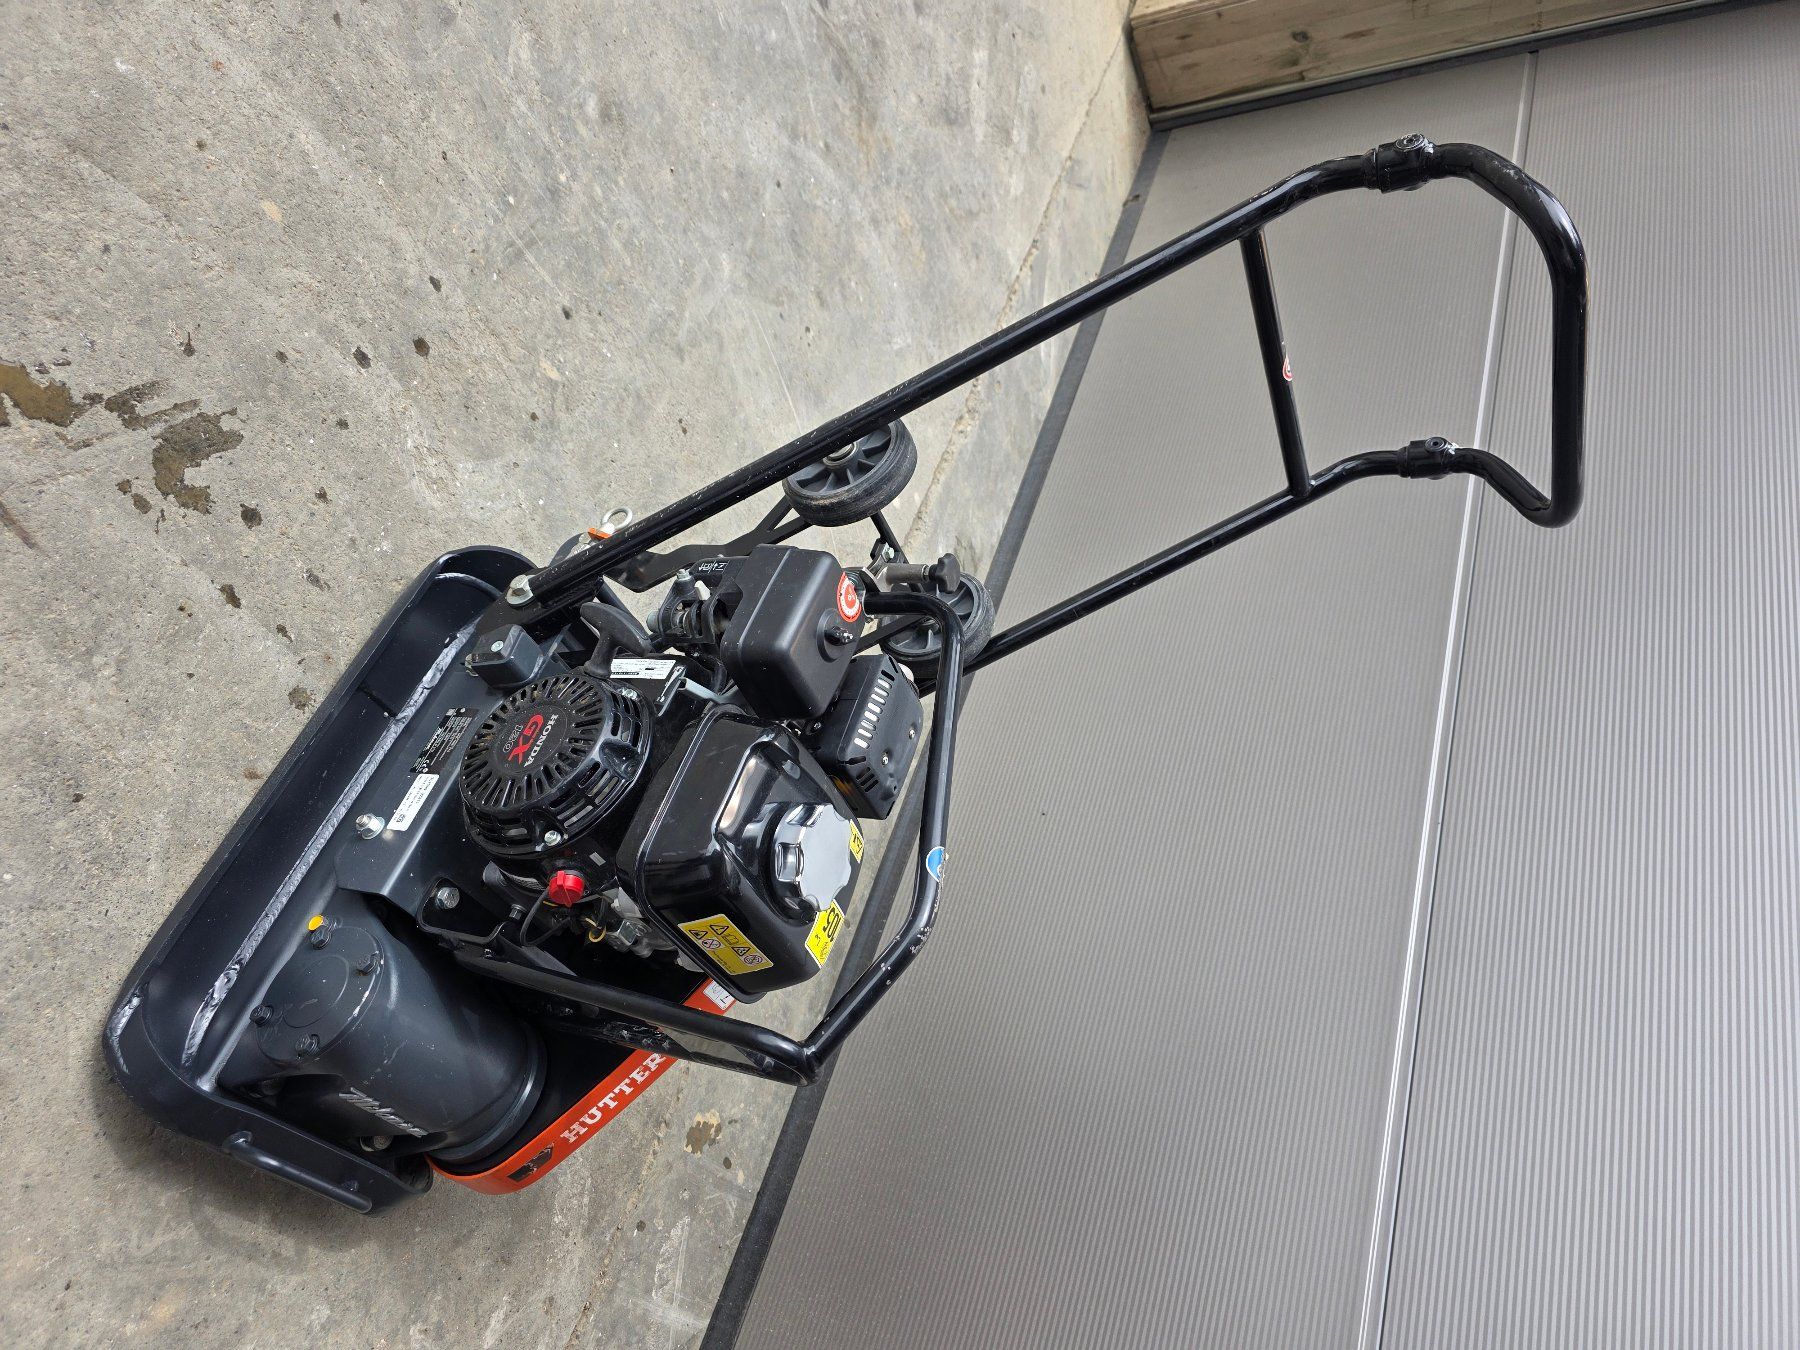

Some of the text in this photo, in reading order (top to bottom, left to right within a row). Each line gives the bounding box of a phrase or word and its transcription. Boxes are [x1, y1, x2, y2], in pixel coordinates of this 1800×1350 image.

[507, 714, 544, 765] GX
[524, 713, 559, 768] HONDA
[823, 907, 842, 942] 105
[560, 1051, 666, 1144] HUTTER
